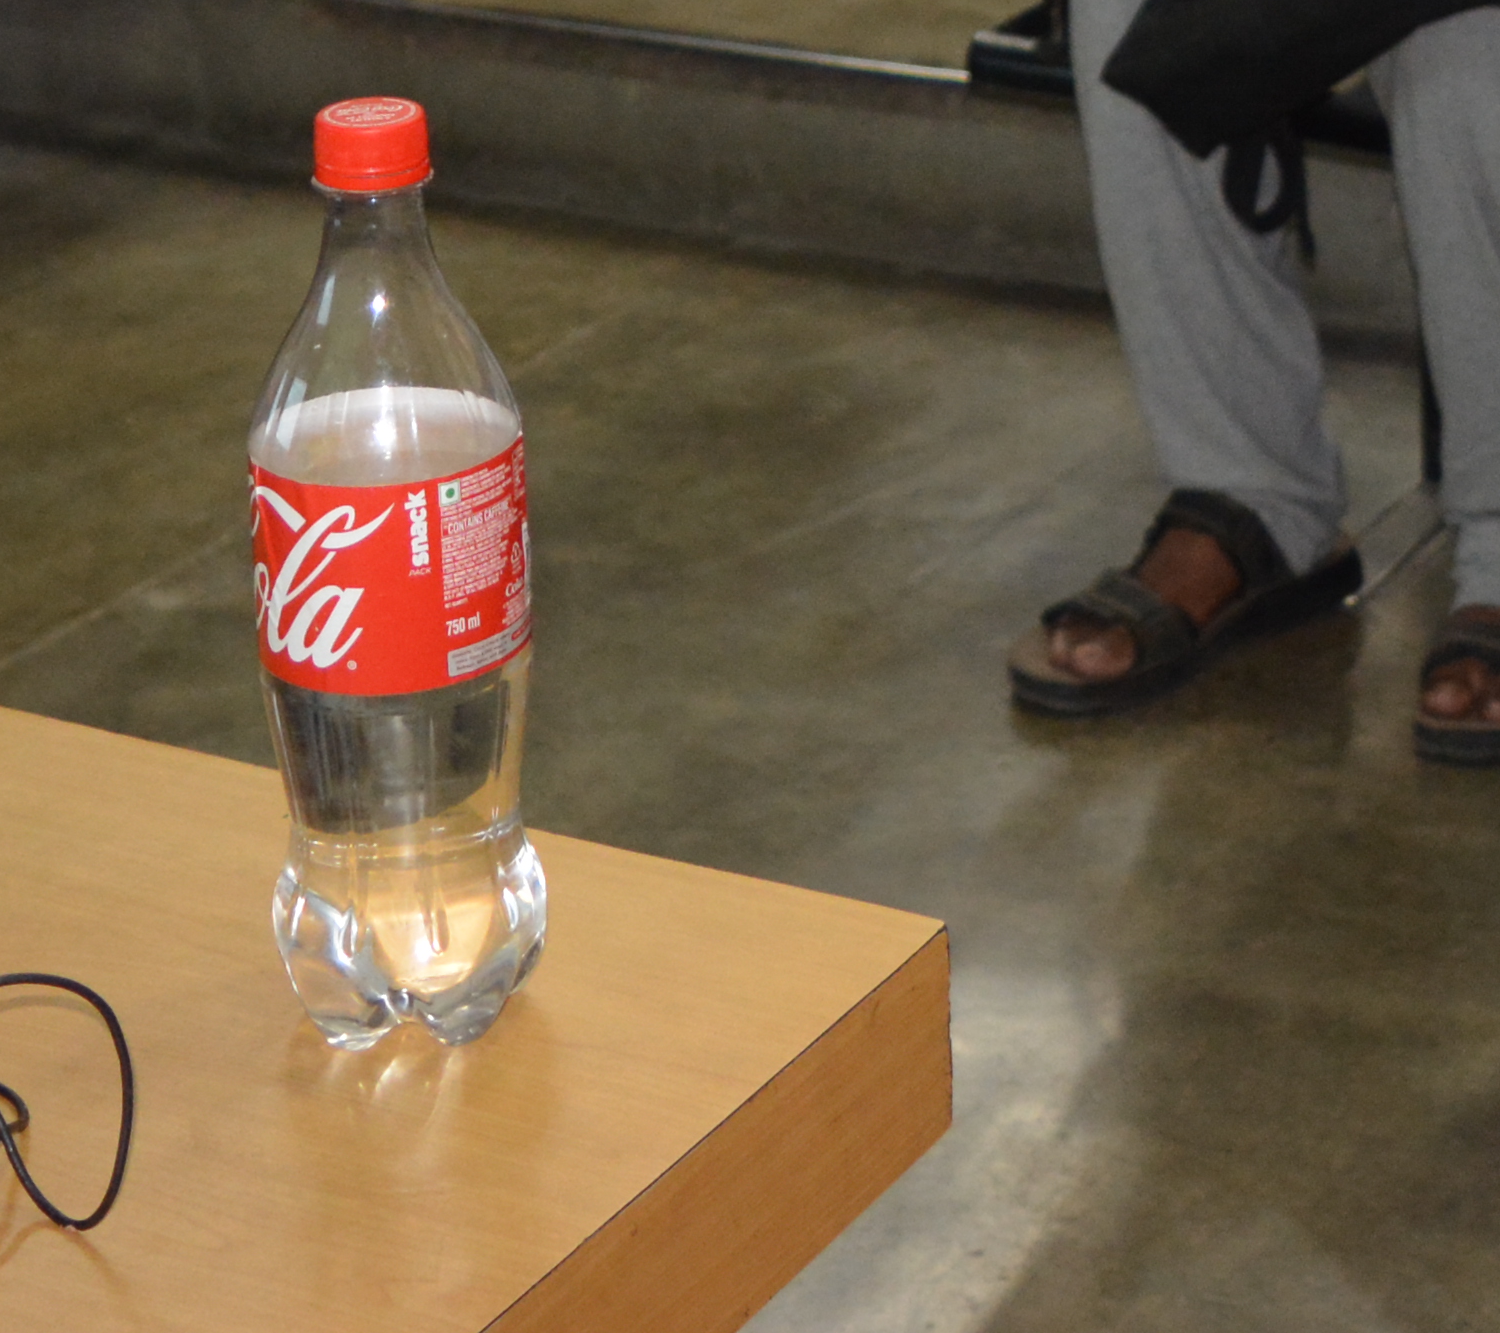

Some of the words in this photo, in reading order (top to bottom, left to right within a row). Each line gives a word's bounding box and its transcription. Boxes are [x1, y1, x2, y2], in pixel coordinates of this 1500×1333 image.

[404, 488, 431, 567] snack
[408, 567, 432, 577] PACK
[445, 617, 466, 636] 750
[467, 611, 481, 631] ml
